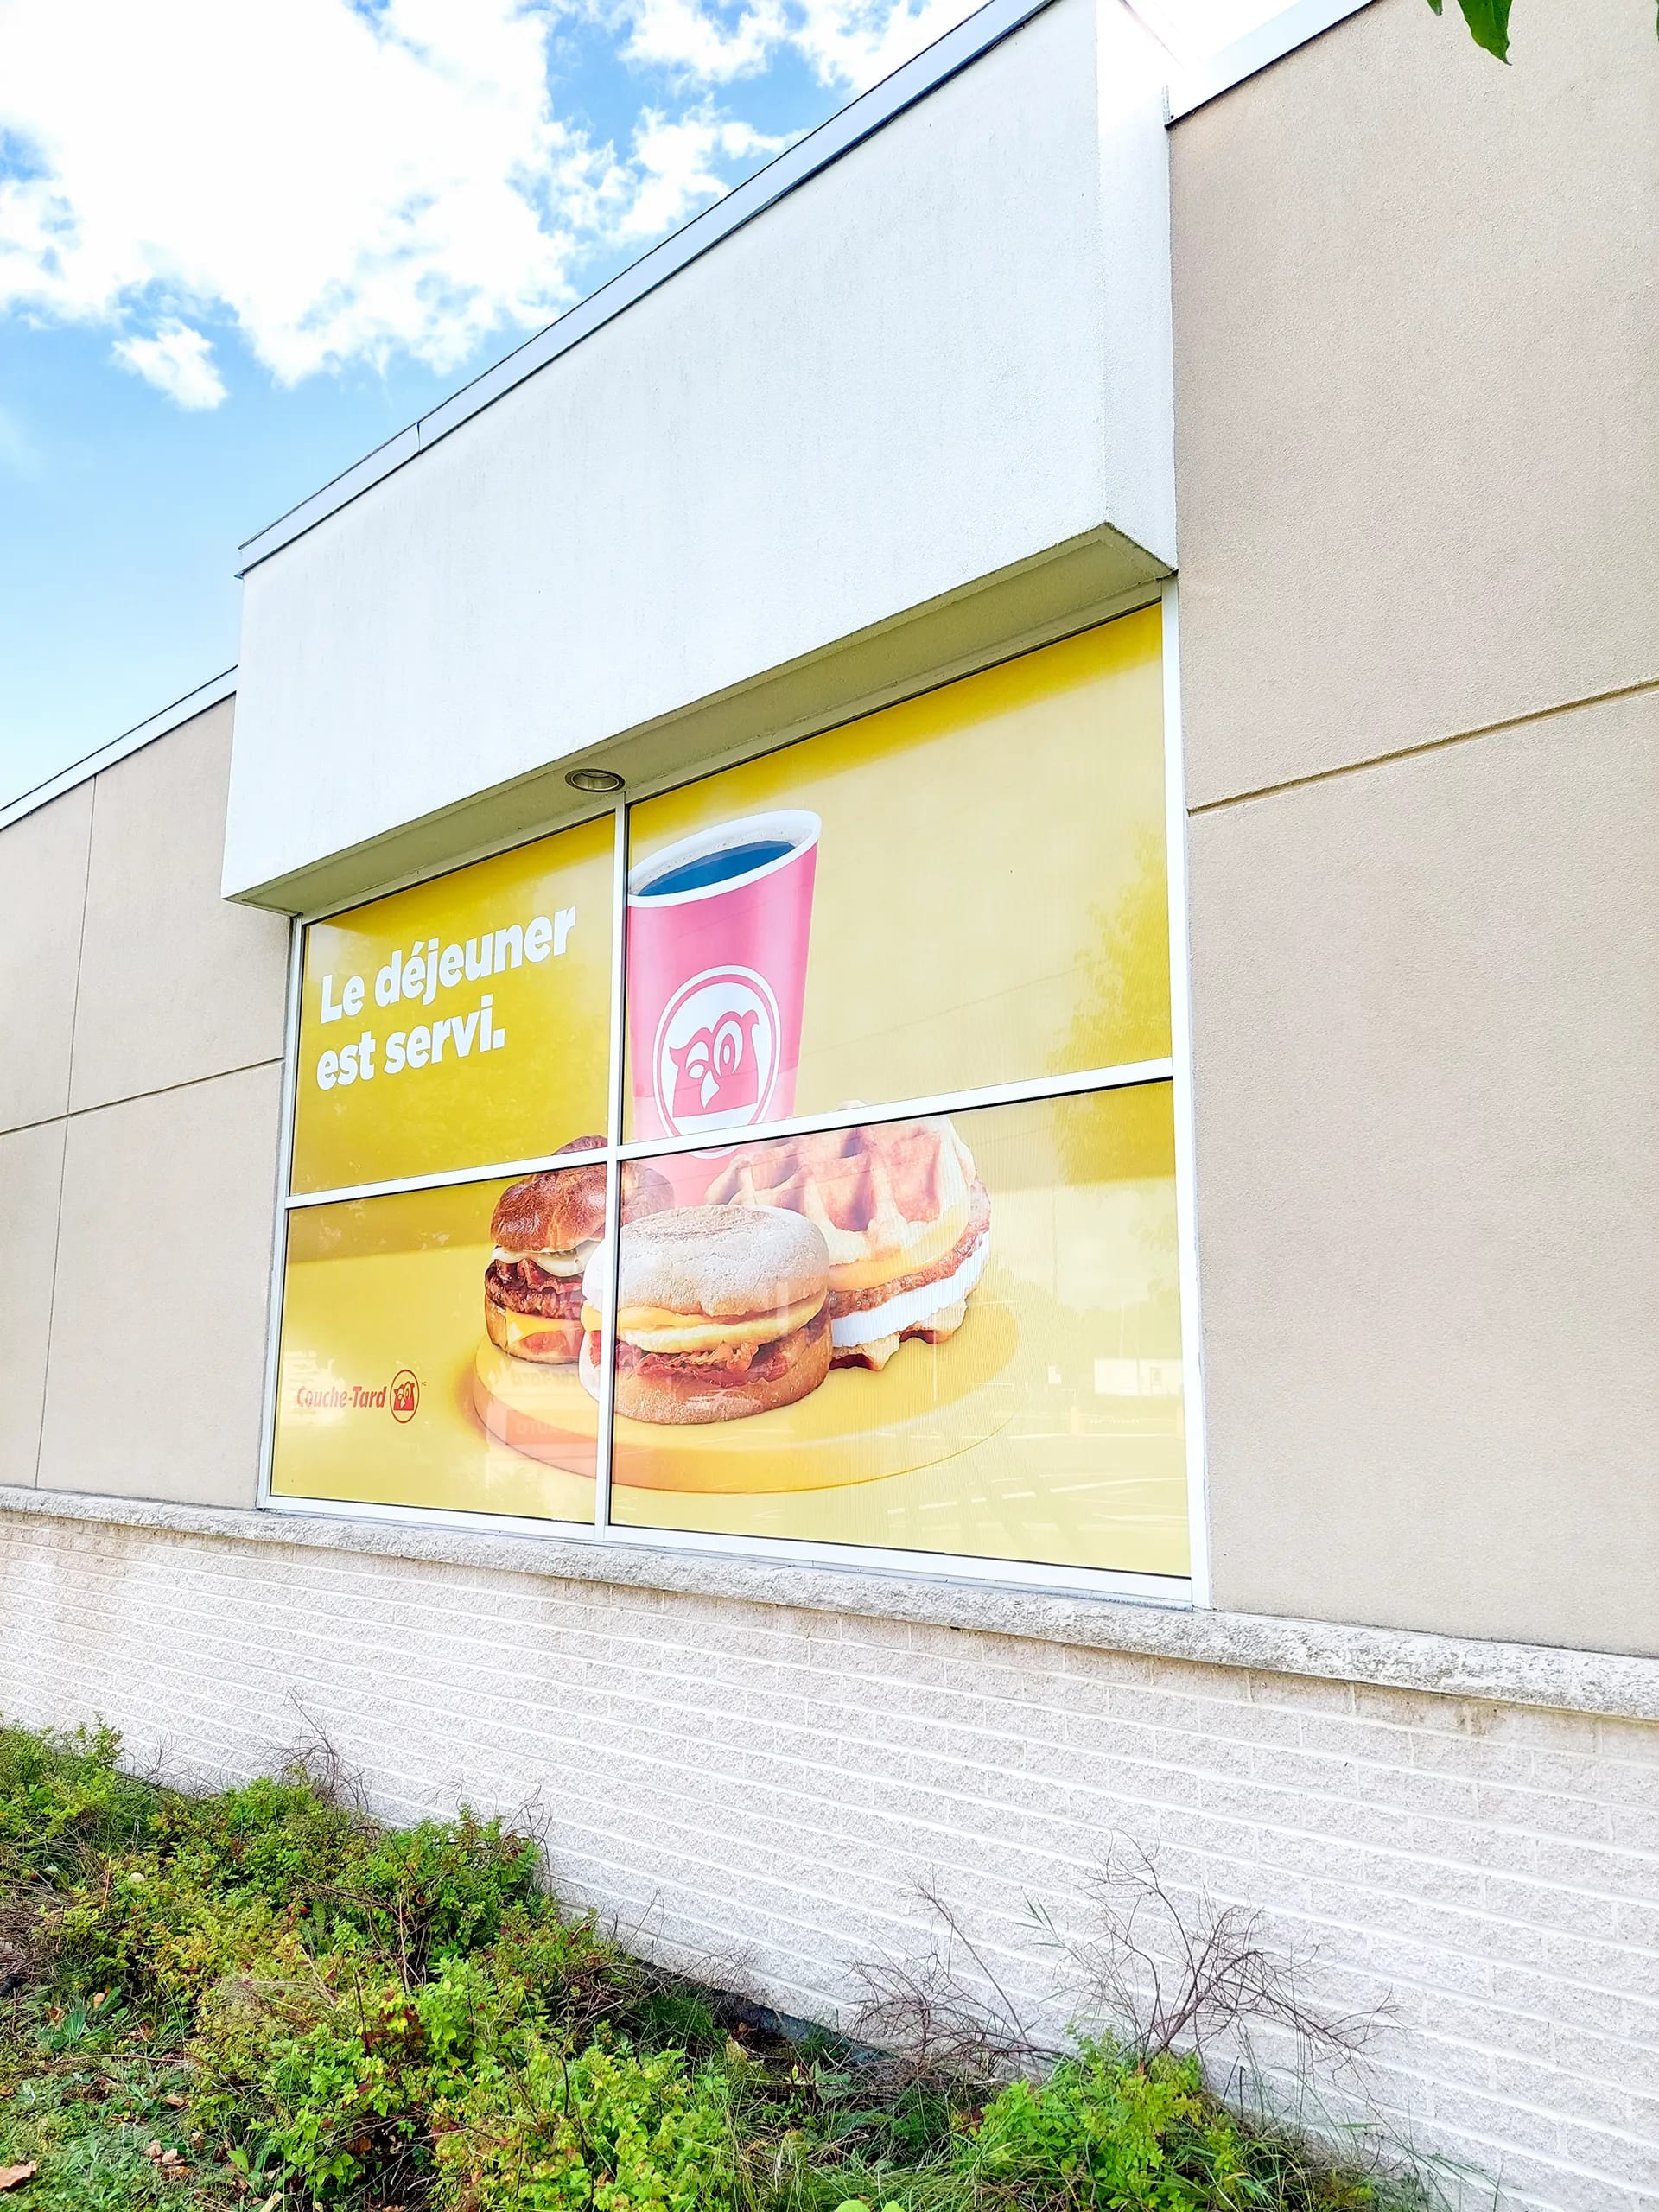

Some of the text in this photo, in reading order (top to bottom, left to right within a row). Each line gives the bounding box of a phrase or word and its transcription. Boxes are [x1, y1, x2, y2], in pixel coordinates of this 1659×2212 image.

[321, 906, 576, 1024] Le déjeuner
[316, 994, 505, 1090] est servi.
[296, 1385, 387, 1408] Couche-Tard
